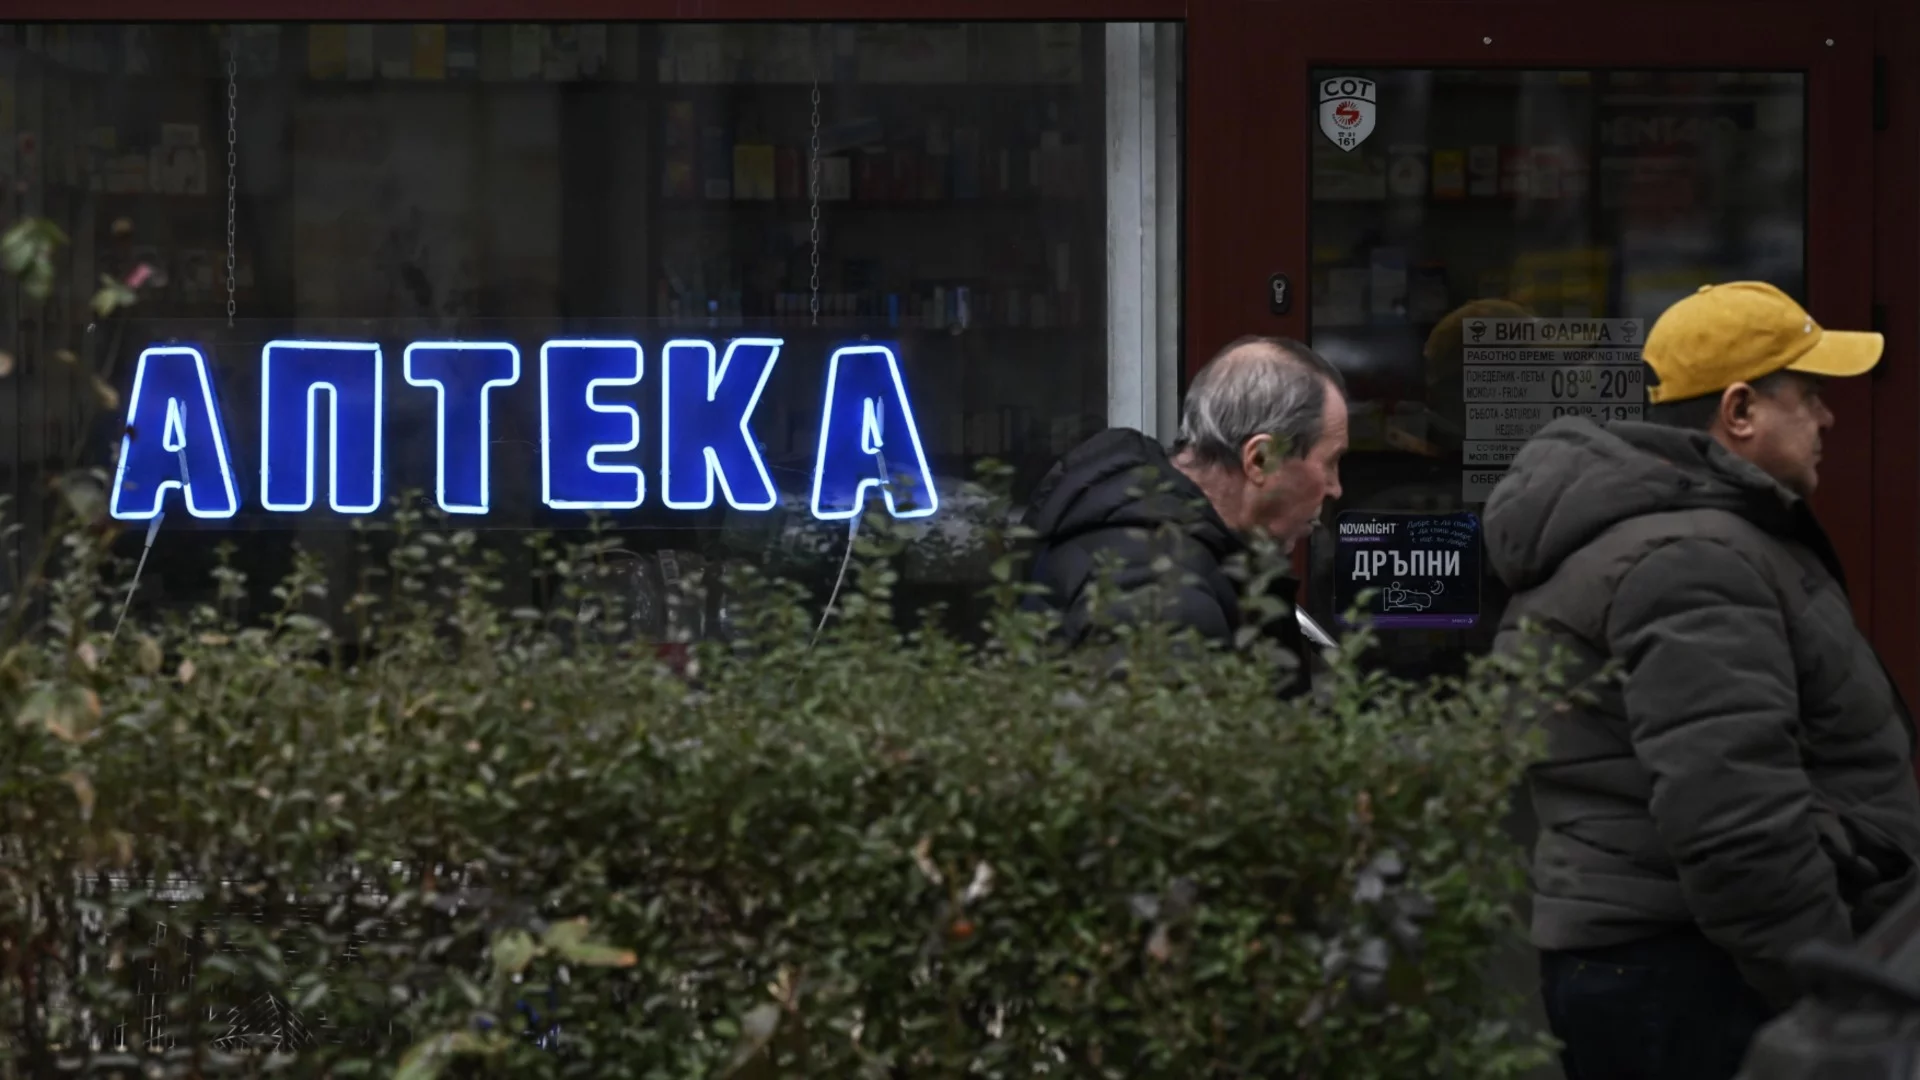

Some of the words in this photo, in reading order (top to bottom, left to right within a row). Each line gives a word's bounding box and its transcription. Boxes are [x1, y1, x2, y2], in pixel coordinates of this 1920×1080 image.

[1324, 80, 1373, 97] СОТ
[1338, 138, 1356, 146] 161
[1495, 323, 1535, 341] ВИП
[1541, 323, 1612, 341] ФАРМА
[1467, 351, 1516, 361] РАБОТНО
[1520, 351, 1555, 361] ВРЕМЕ
[1563, 351, 1613, 361] WORKING
[1617, 352, 1640, 361] TIME
[1521, 370, 1546, 382] ПЕТЪК
[1502, 387, 1528, 398] FRIDAY
[1469, 408, 1498, 419] СЪБОТА
[1504, 408, 1541, 420] SATURDAY
[110, 337, 939, 520] АПТЕКА
[1492, 453, 1517, 461] СВЕТ
[1339, 520, 1397, 535] NOVANIGHT
[1352, 550, 1460, 581] ДРЪПНИ
